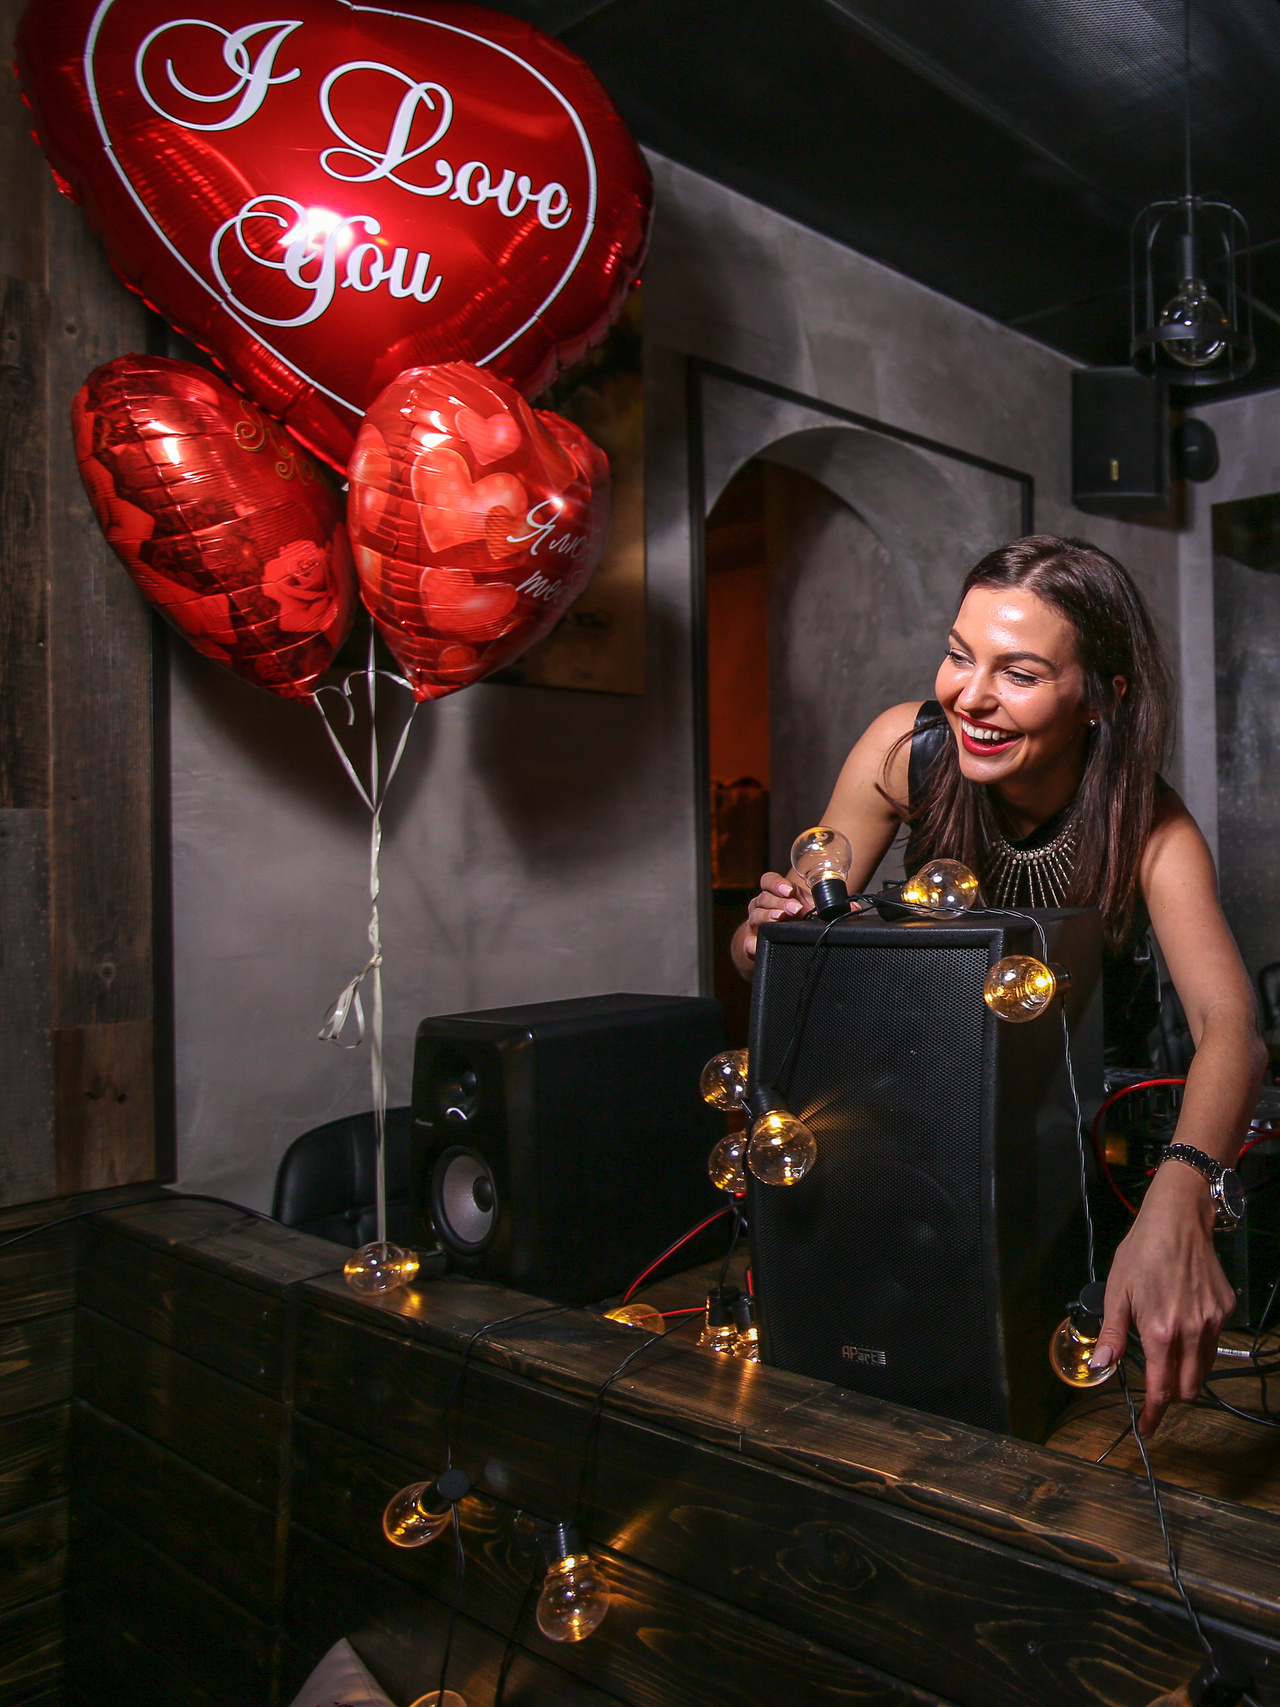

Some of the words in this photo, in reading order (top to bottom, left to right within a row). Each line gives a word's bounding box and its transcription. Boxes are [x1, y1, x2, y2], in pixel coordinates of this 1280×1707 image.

[134, 18, 304, 132] I
[318, 60, 572, 231] Love
[210, 194, 443, 328] You
[506, 496, 566, 556] Я
